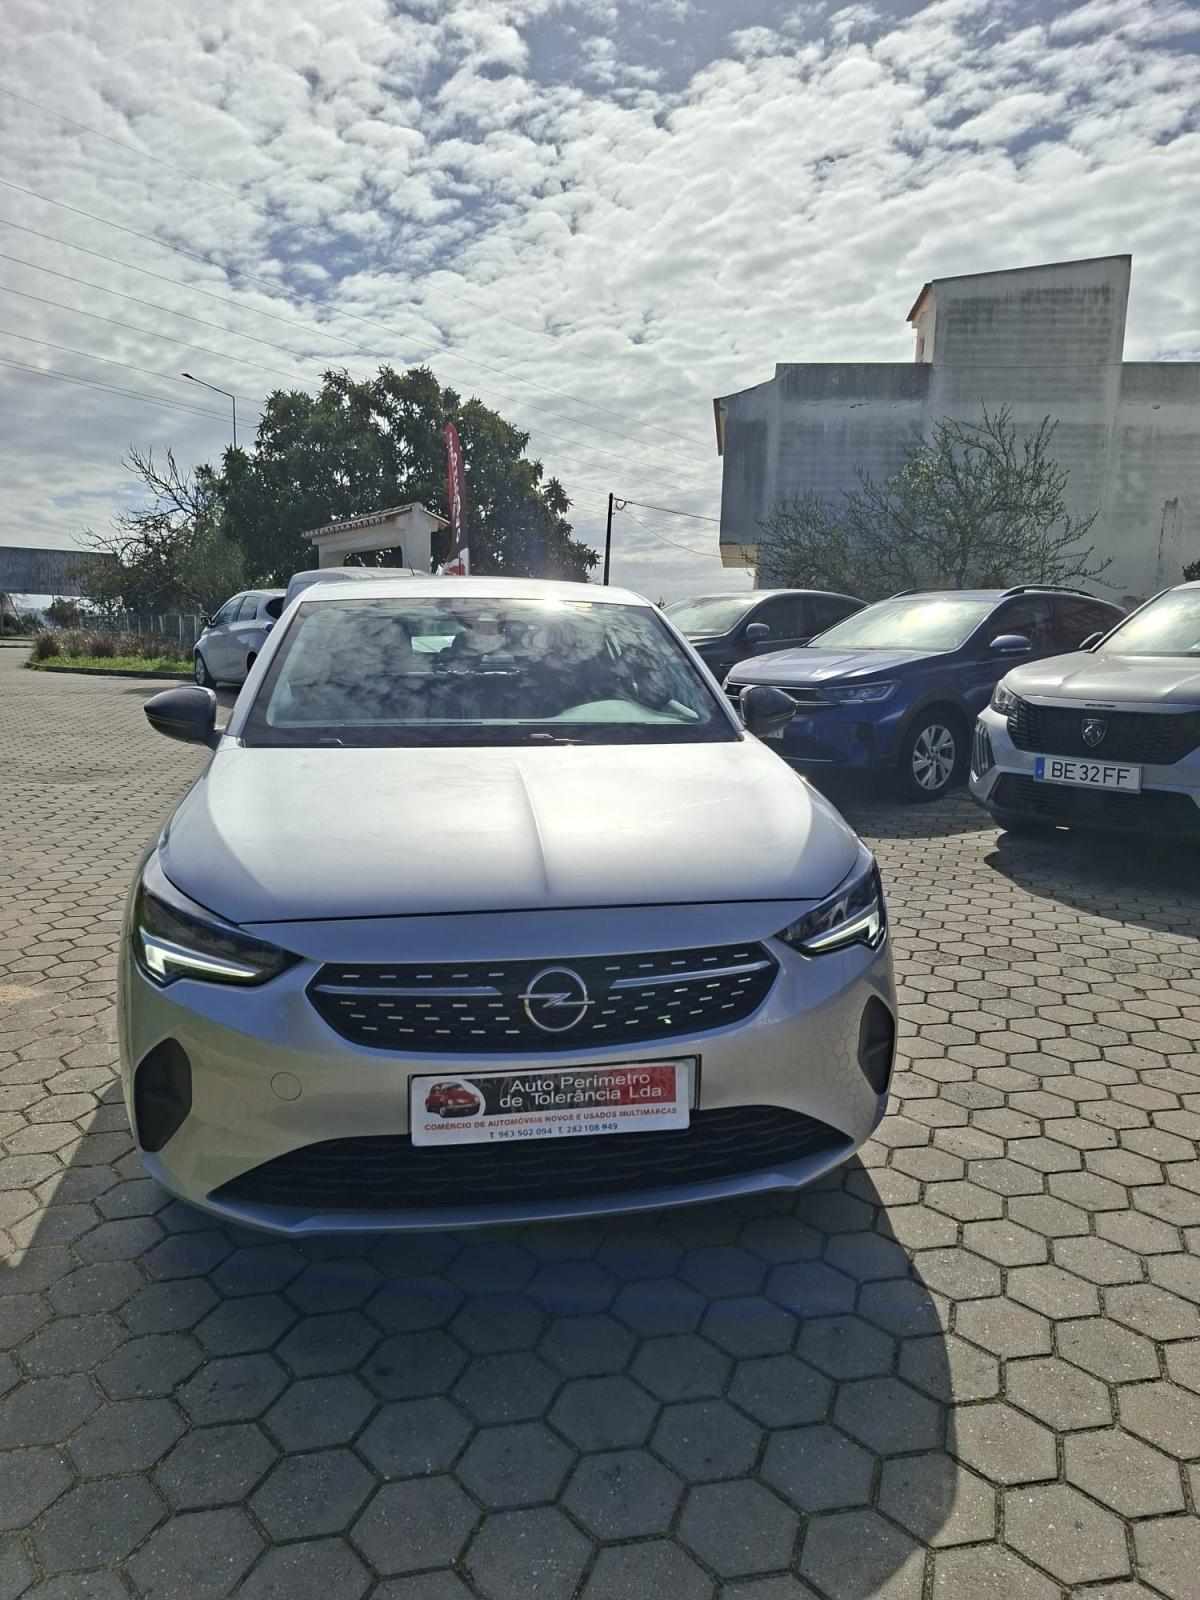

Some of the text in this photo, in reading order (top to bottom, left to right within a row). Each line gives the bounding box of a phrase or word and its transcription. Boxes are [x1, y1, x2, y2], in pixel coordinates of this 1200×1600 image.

[510, 1078, 554, 1093] Auto
[499, 1094, 523, 1108] de
[530, 1088, 621, 1105] Tolerância
[474, 1120, 486, 1128] DE
[545, 1113, 574, 1122] NOVOS
[583, 1110, 617, 1120] USADOS
[619, 1107, 677, 1118] MULTIMARCAS
